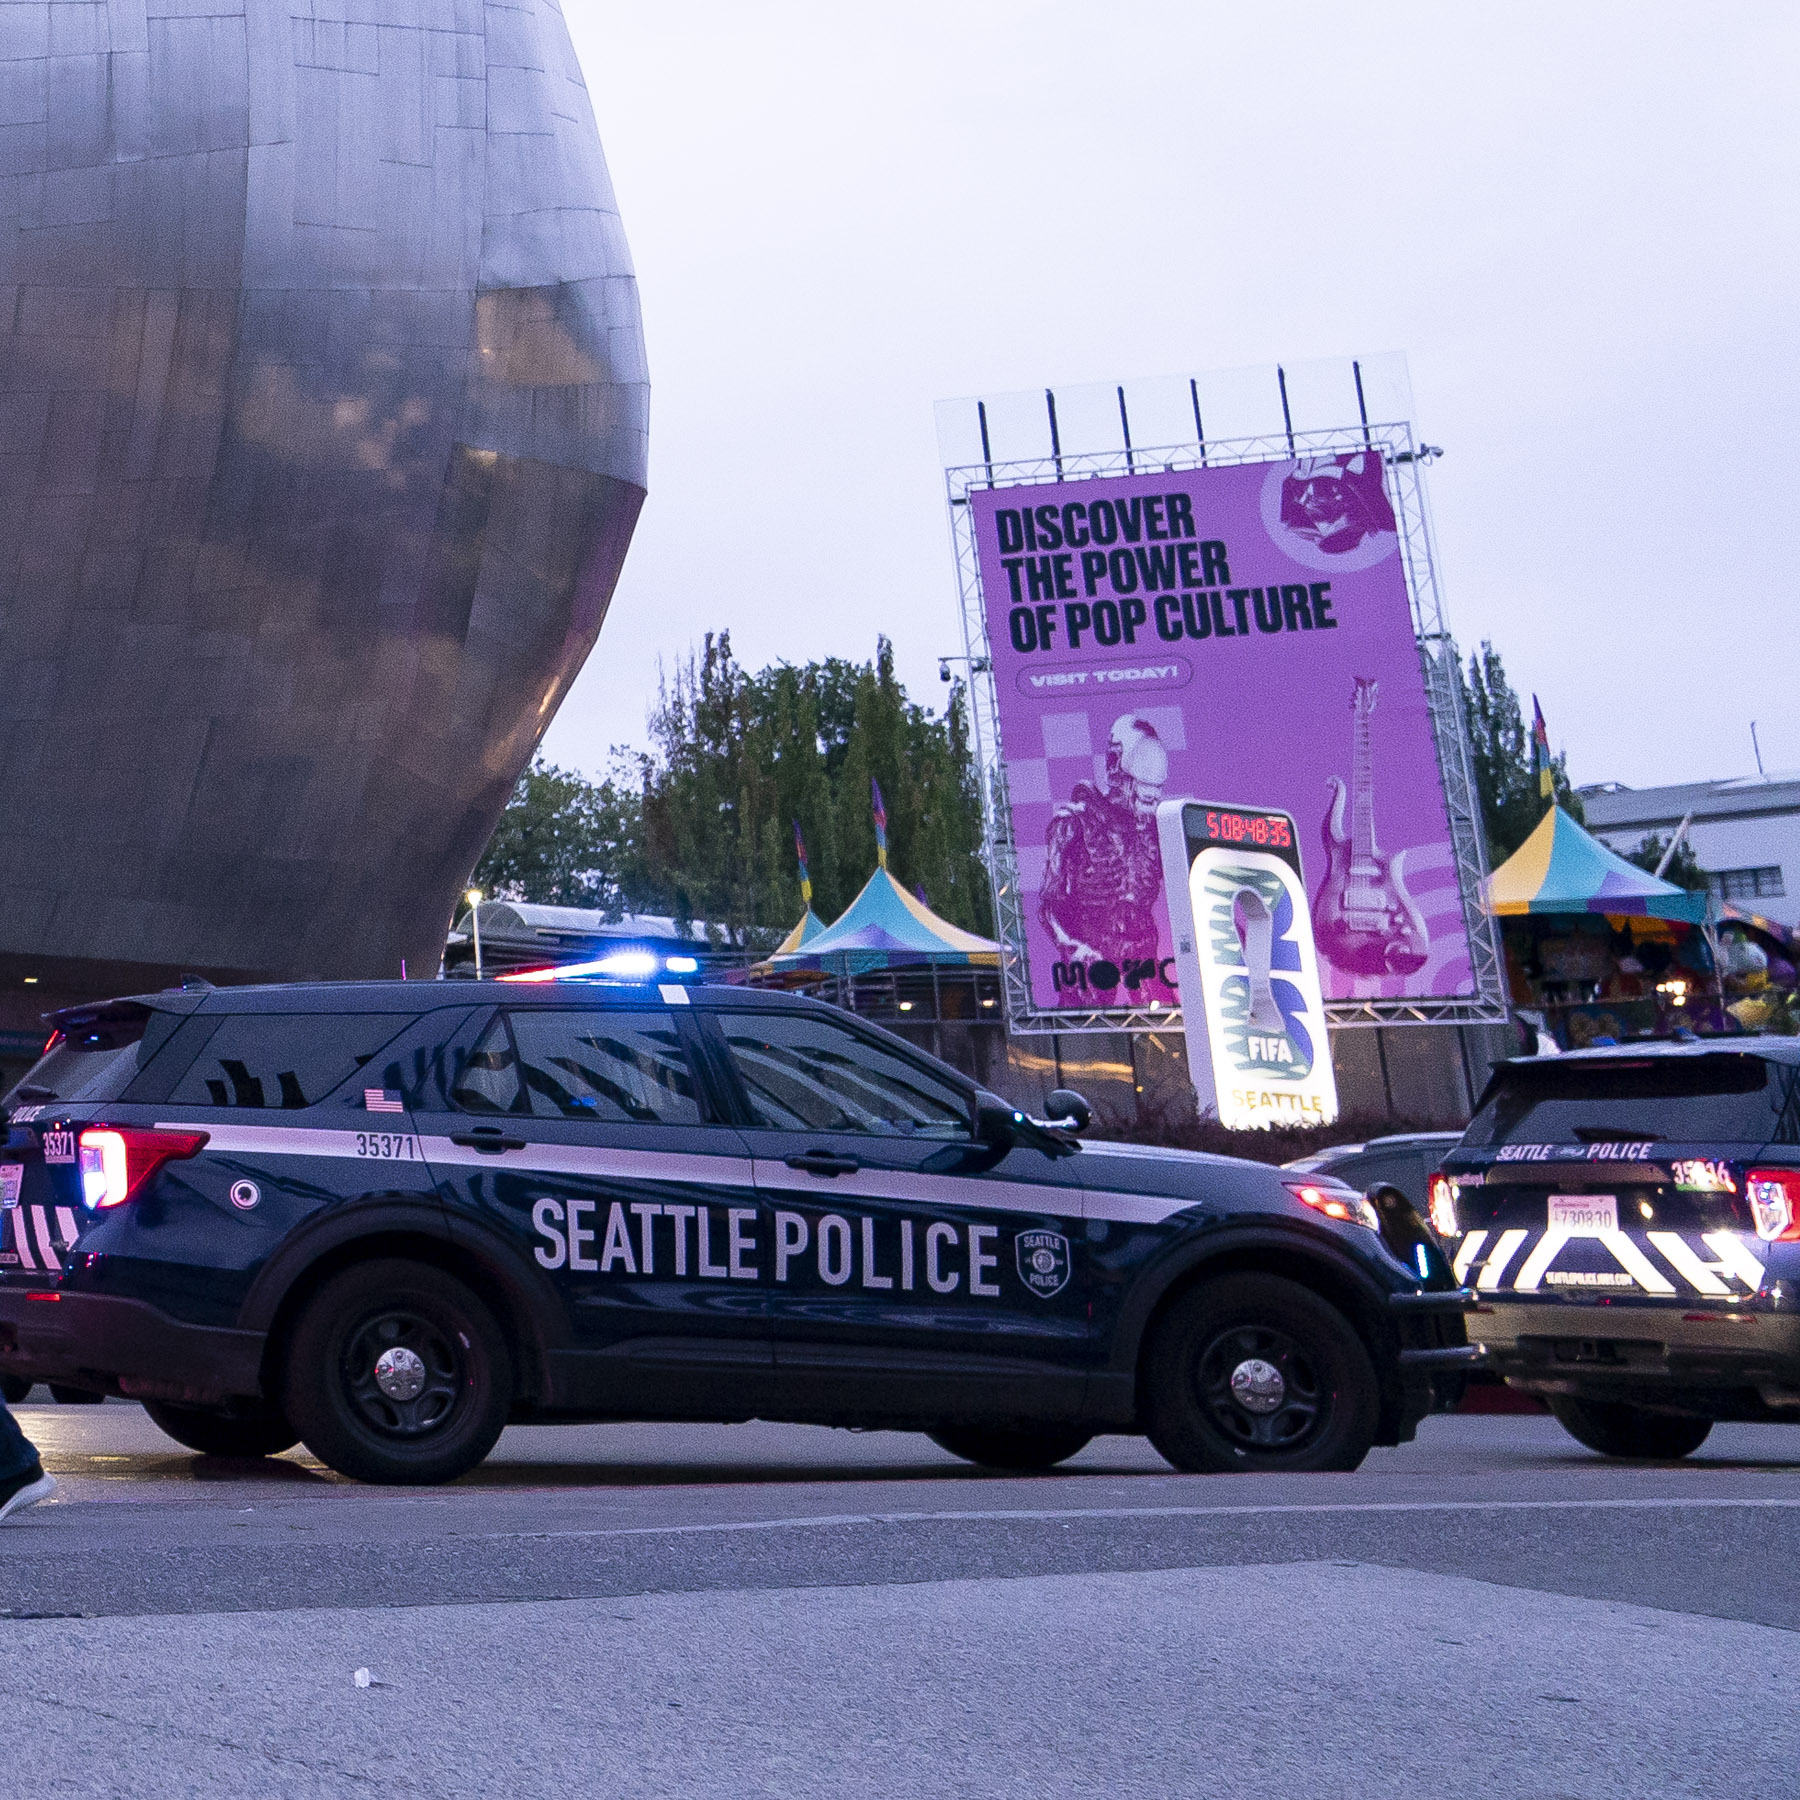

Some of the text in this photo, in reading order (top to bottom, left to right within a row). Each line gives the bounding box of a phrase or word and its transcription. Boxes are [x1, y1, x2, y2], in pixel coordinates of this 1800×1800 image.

[995, 492, 1196, 554] DISCOVER
[1000, 540, 1231, 603] THE POWER
[1008, 581, 1338, 653] OF POP CULTURE
[1029, 665, 1179, 688] VISIT TODAY!
[1249, 1036, 1293, 1064] FIFA
[1231, 1089, 1323, 1113] SEATTLE
[43, 1131, 76, 1156] 35371
[356, 1133, 414, 1159] 35371
[1496, 1143, 1653, 1161] SEATTLE POLICE
[531, 1197, 1000, 1296] SEATTLE POLICE
[1023, 1234, 1061, 1250] SEATTLE
[1029, 1273, 1059, 1287] POLICE
